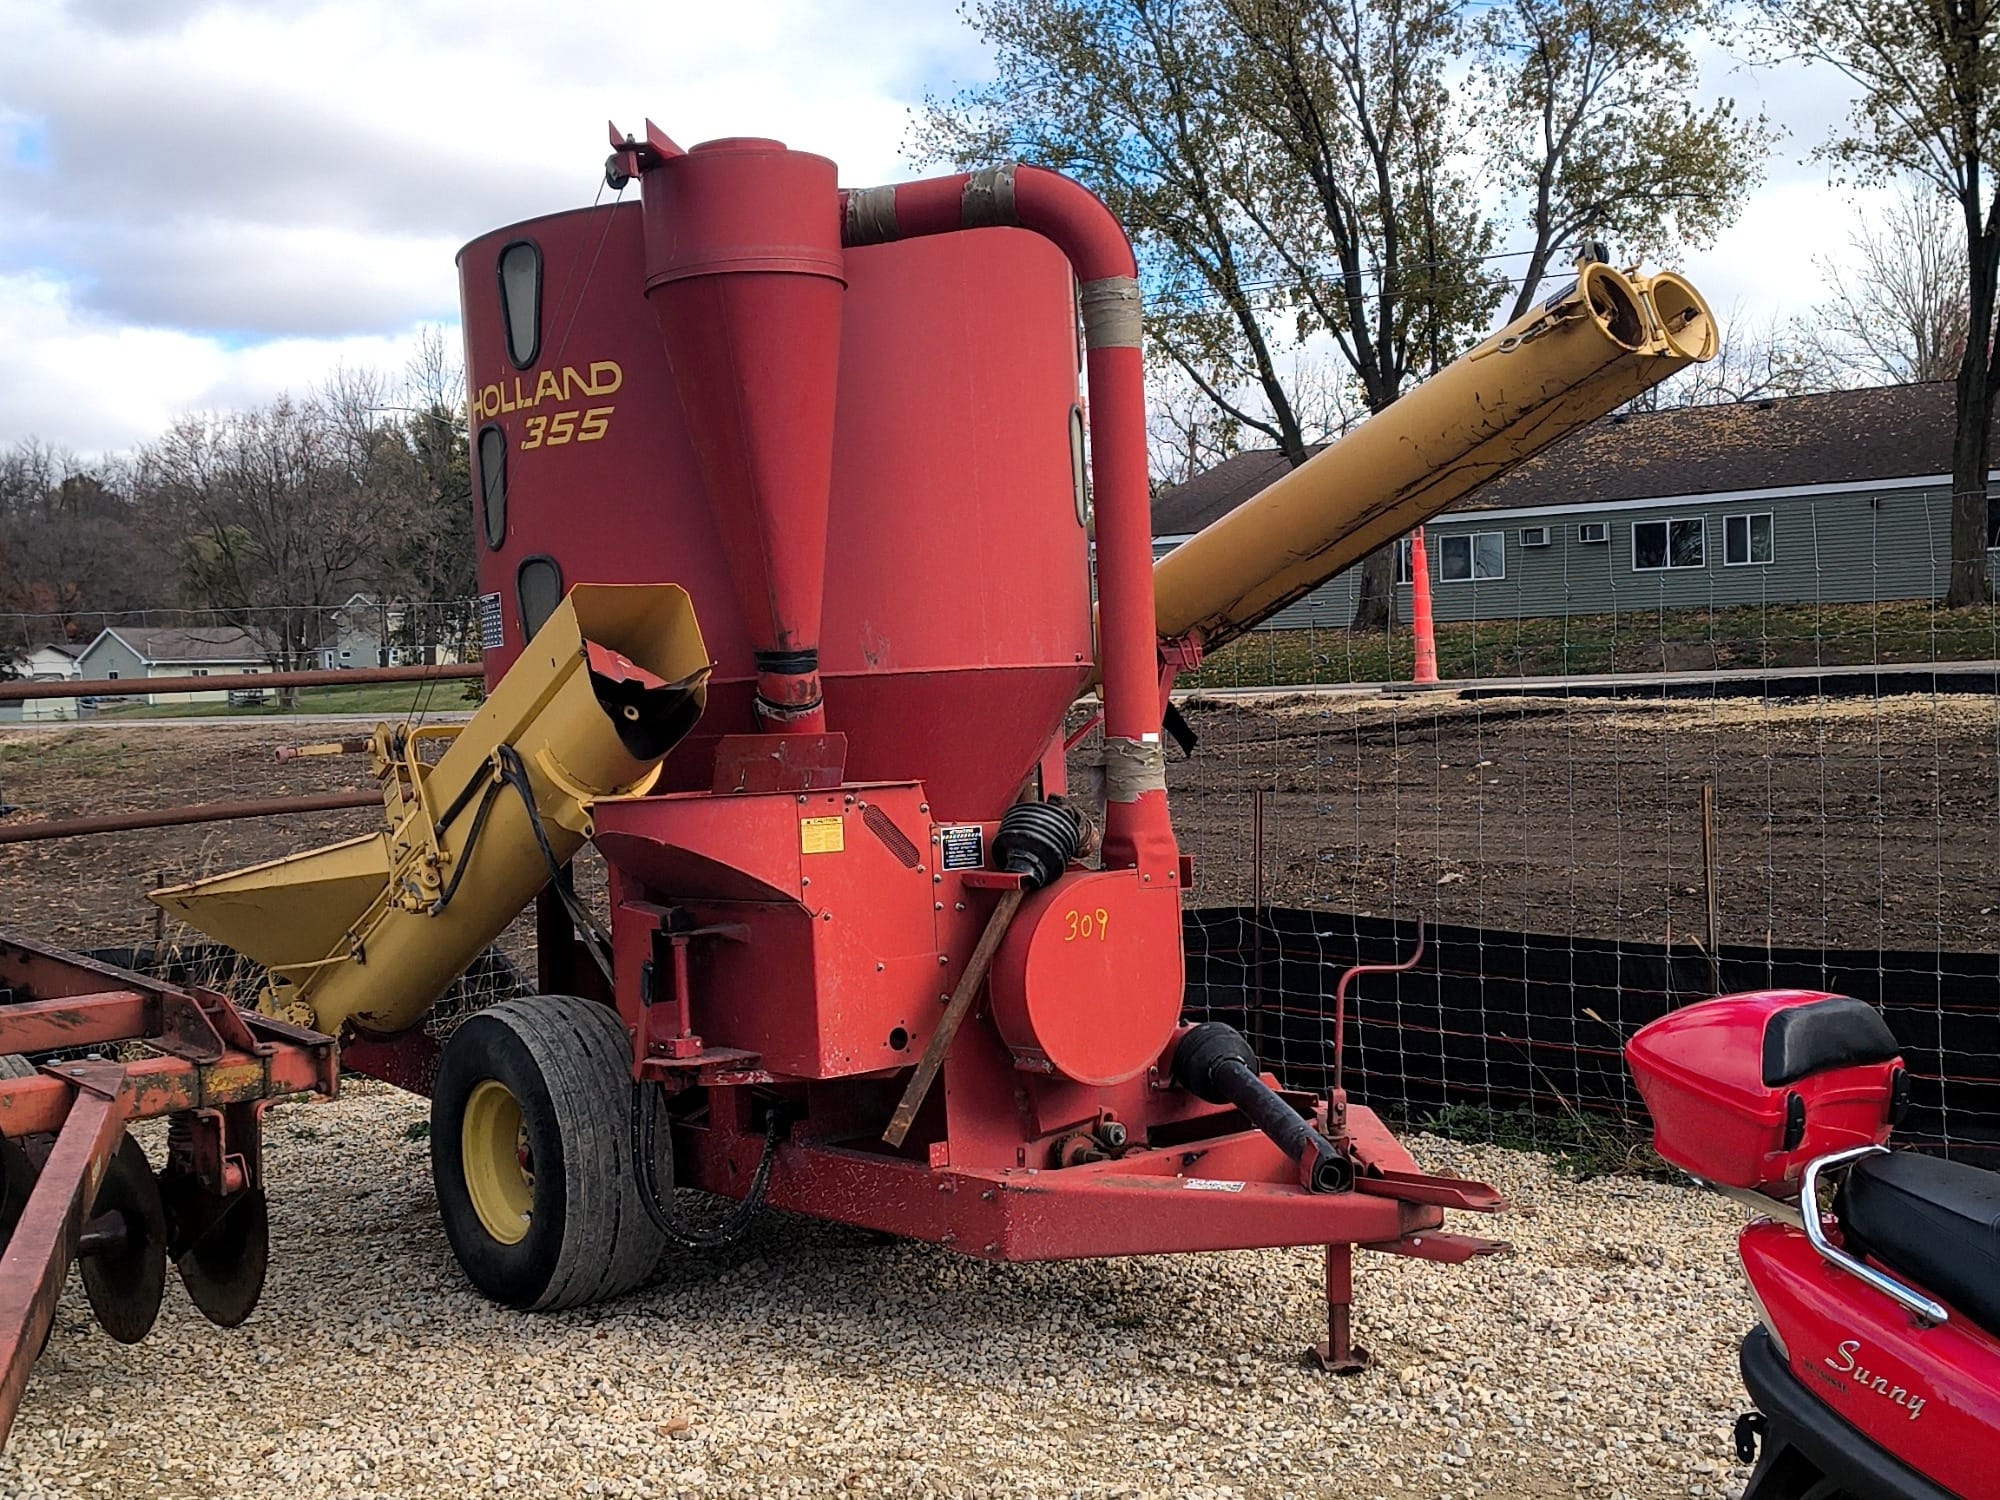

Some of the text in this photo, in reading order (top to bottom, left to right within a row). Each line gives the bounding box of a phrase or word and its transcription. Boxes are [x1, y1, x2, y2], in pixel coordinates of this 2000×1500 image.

[472, 360, 623, 424] HOLLAND
[520, 406, 615, 450] 355
[1064, 908, 1108, 941] 309
[1824, 1340, 1927, 1420] Sunny
